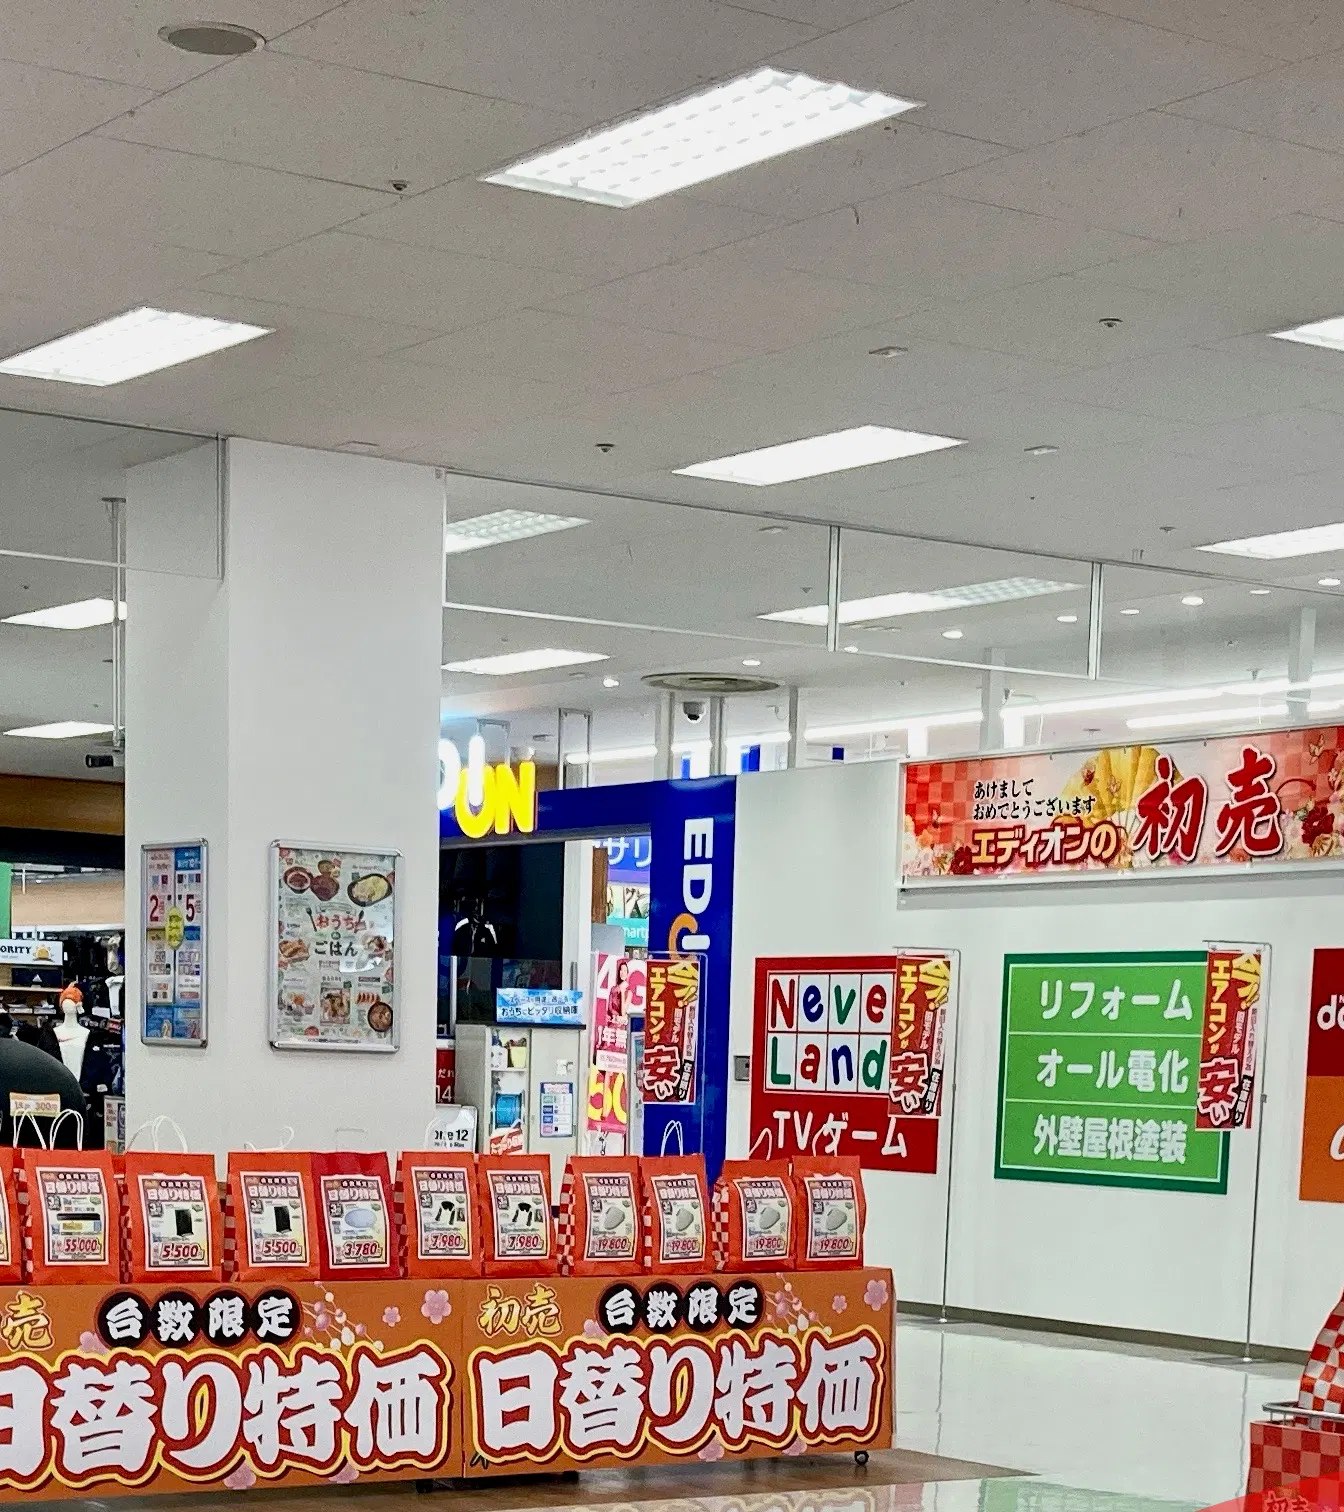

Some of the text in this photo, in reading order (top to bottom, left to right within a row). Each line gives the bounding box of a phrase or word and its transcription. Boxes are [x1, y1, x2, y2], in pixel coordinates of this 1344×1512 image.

[971, 747, 1285, 865] エディオンの 初売
[973, 794, 1097, 821] おめでとうございます
[974, 777, 1035, 799] あけまして
[149, 895, 159, 922] 2
[186, 895, 196, 923] 5
[314, 941, 359, 957] ごはん
[769, 978, 888, 1030] Neve
[1040, 978, 1193, 1021] リフォーム
[770, 1035, 888, 1091] Land
[1036, 1048, 1190, 1094] オール電化
[772, 1109, 908, 1158] TVゲーム
[1032, 1112, 1189, 1165] 外壁屋根塗装
[105, 1296, 295, 1344] 台数限定
[478, 1283, 759, 1337] 初売 台数限定
[478, 1337, 878, 1450] 日替り特価
